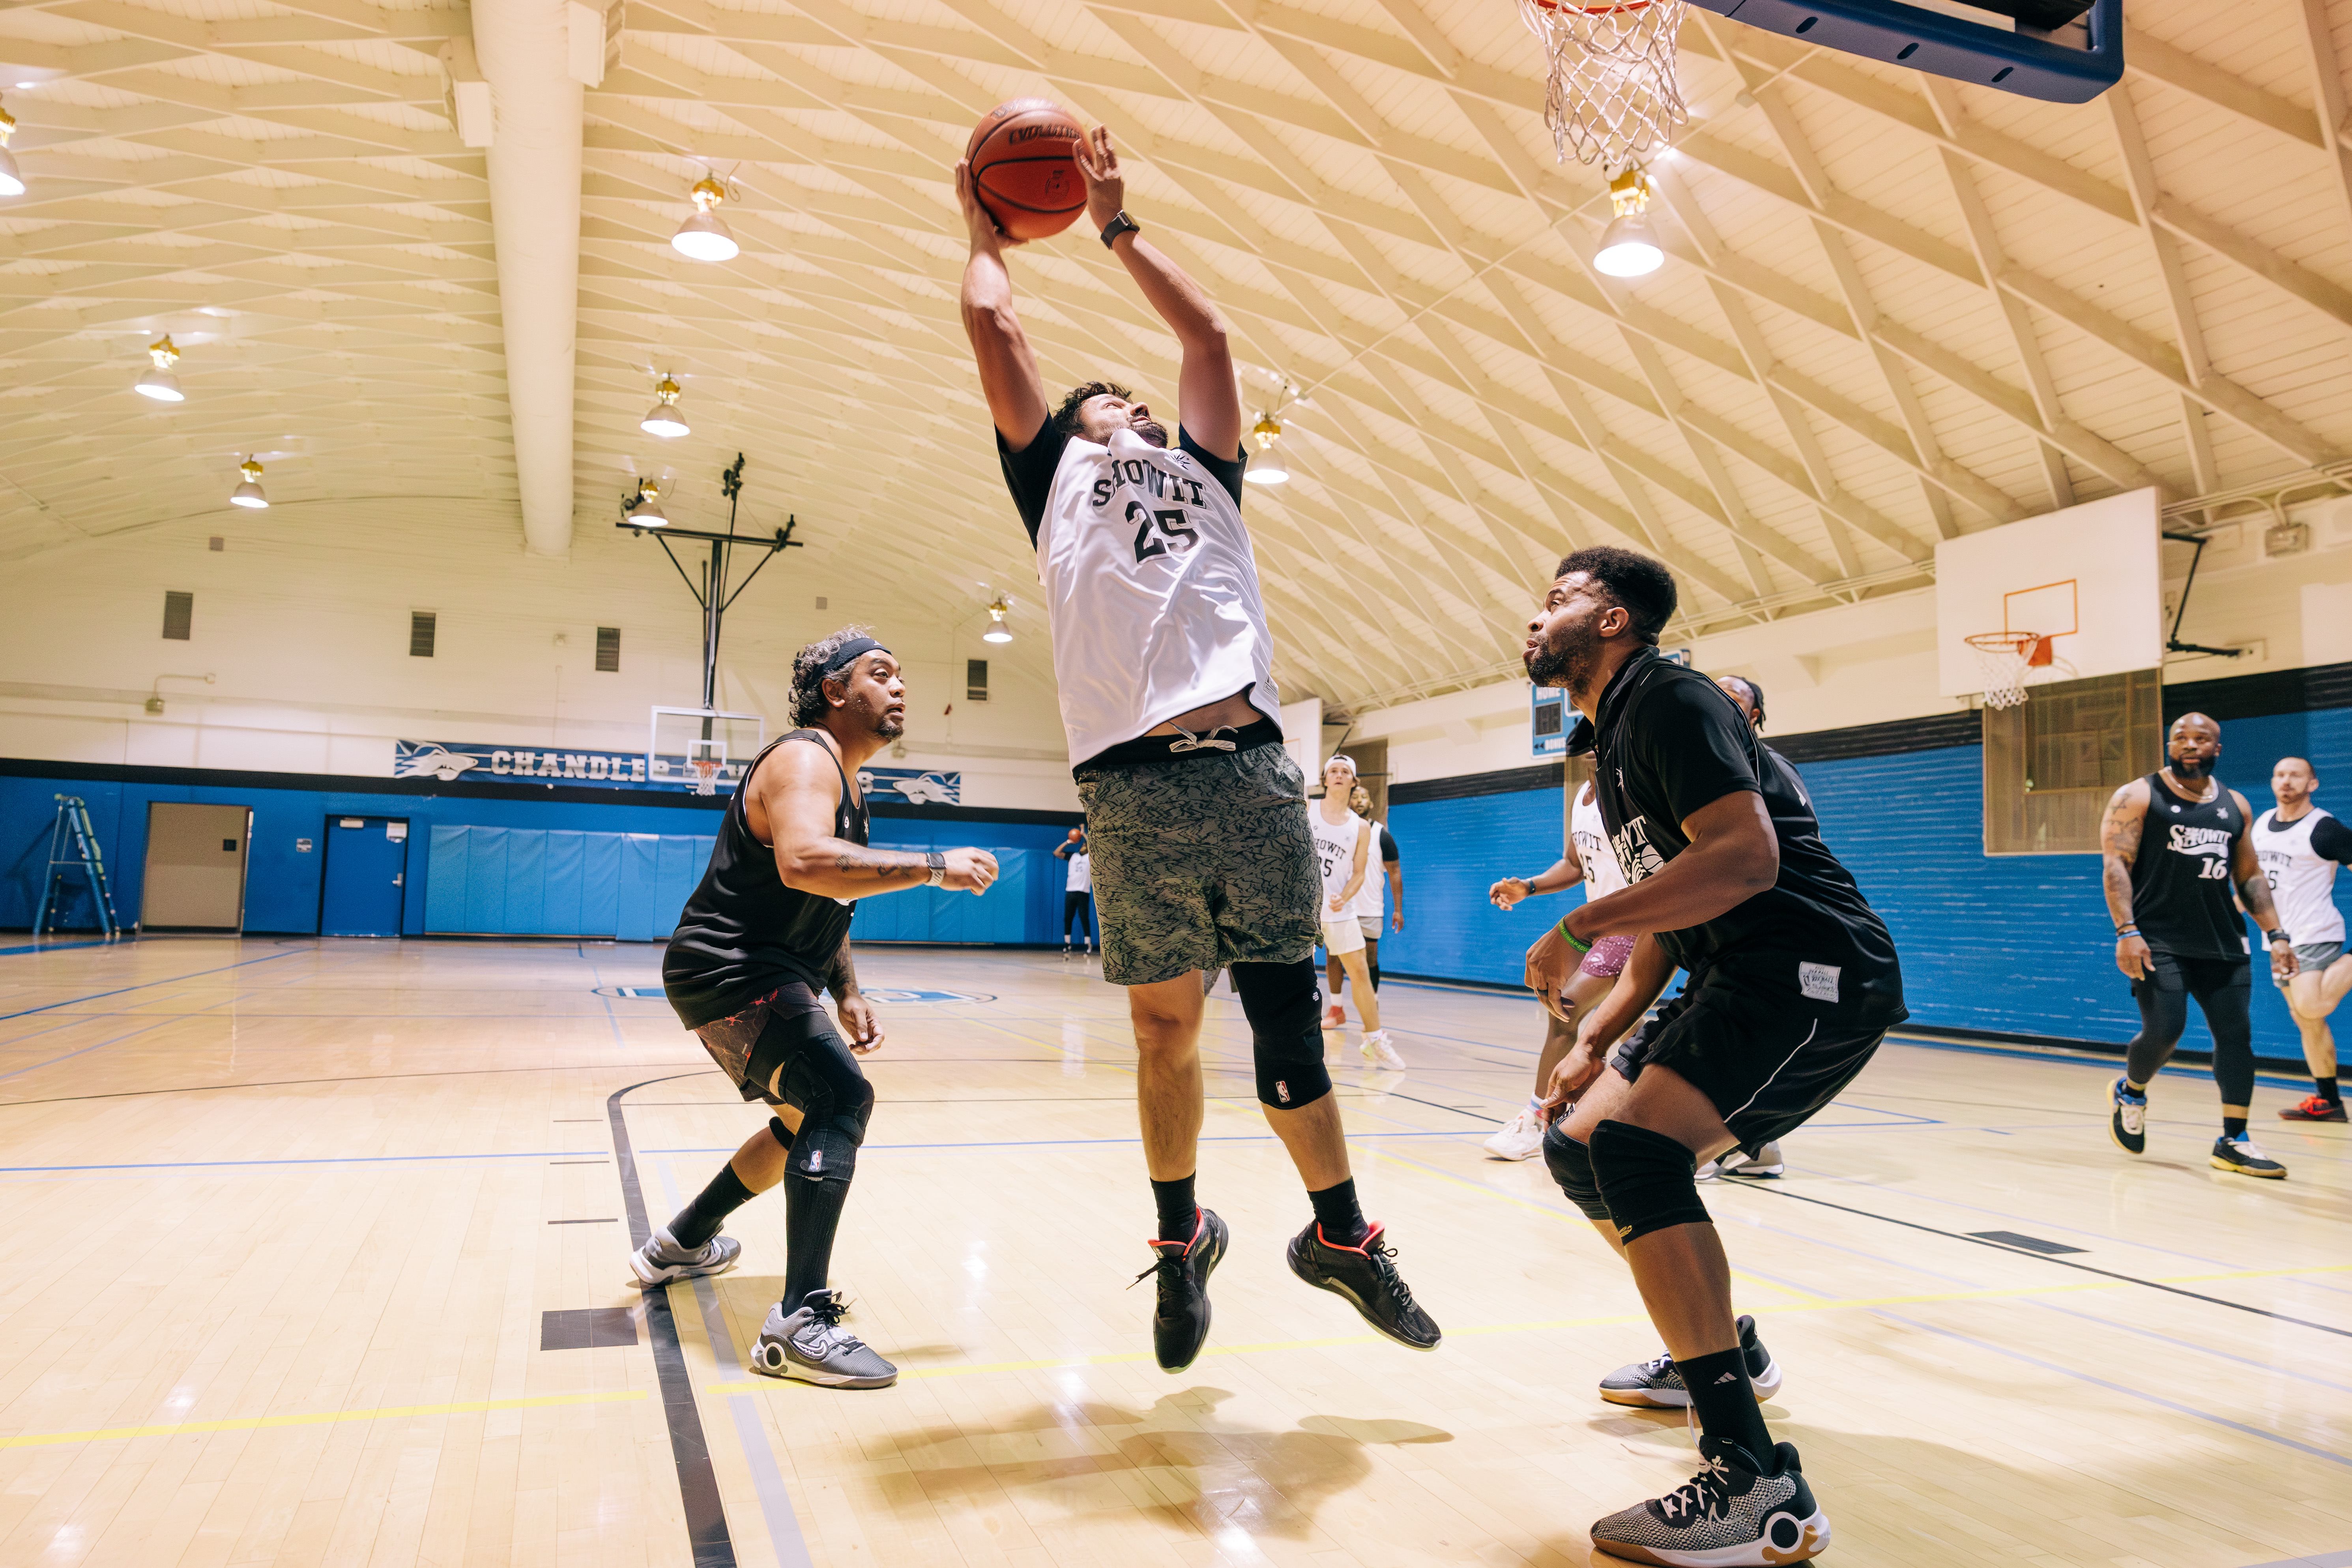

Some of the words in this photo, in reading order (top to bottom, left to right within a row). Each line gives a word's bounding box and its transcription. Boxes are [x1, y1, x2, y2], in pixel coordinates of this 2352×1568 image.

[1125, 501, 1207, 564] 25
[491, 750, 670, 783] CHANDLER
[1314, 838, 1346, 860] HOWIT
[2197, 857, 2228, 880] 16
